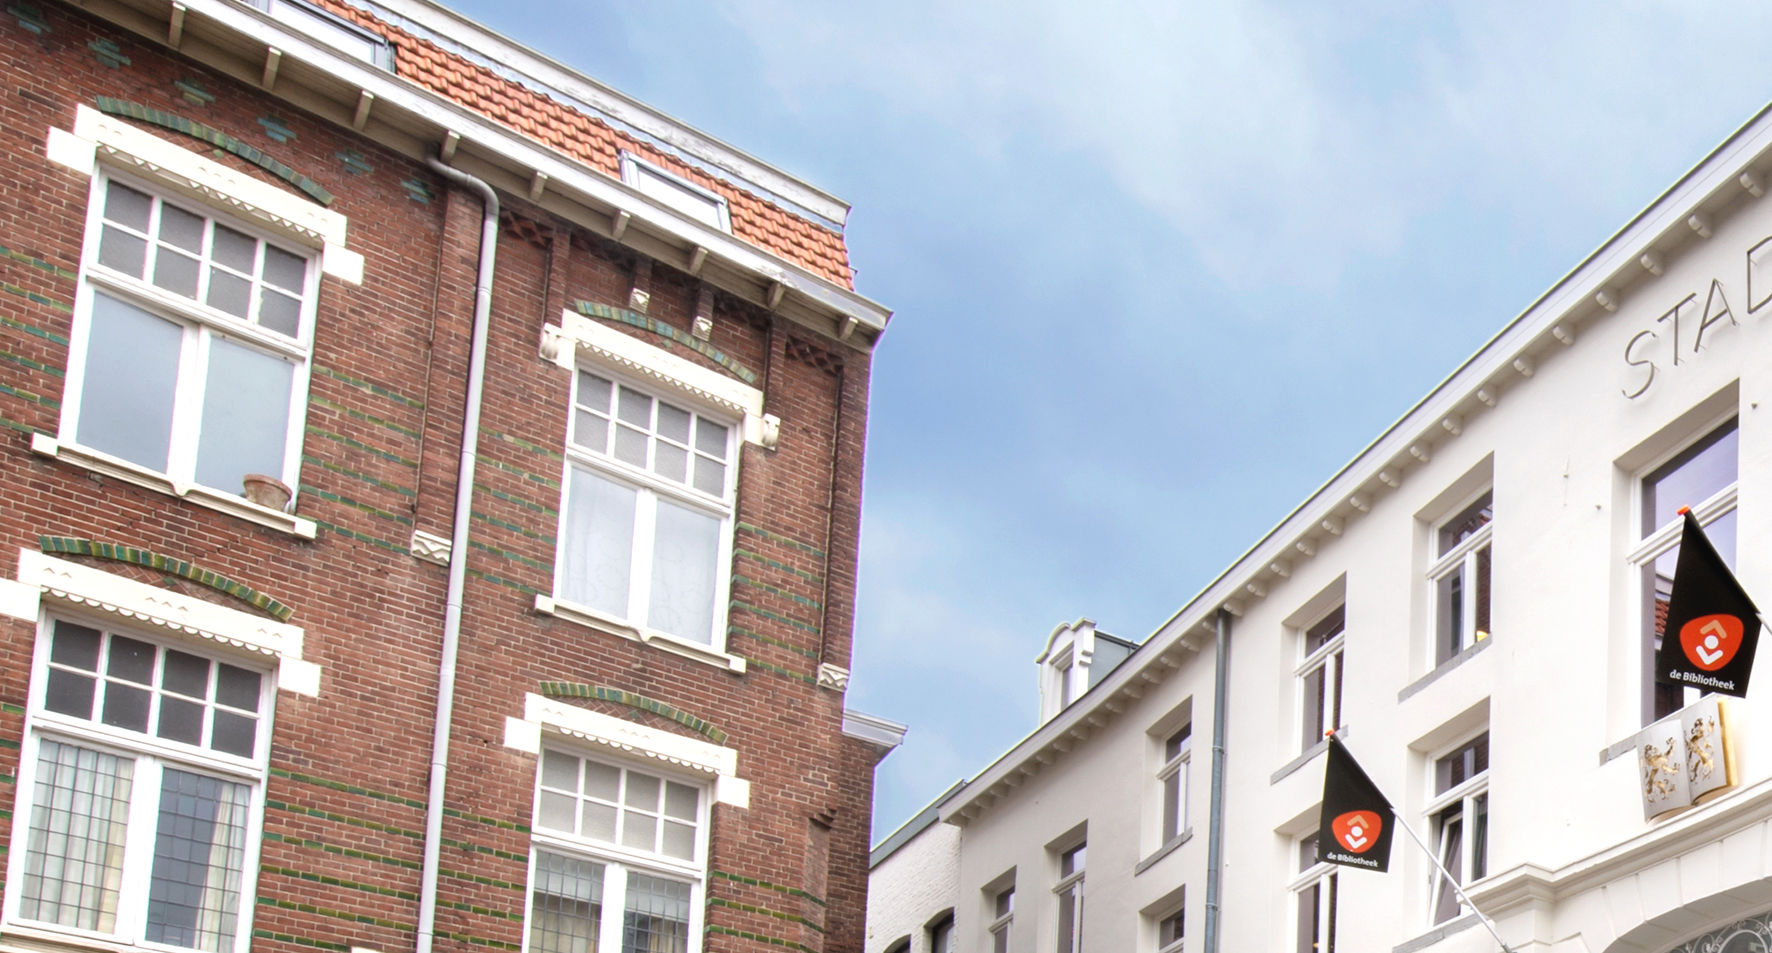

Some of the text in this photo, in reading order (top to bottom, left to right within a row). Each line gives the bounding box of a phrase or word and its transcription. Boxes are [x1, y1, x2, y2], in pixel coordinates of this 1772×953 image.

[1669, 669, 1735, 690] de Bibliotheek
[1327, 852, 1379, 867] de Bibliotheek
